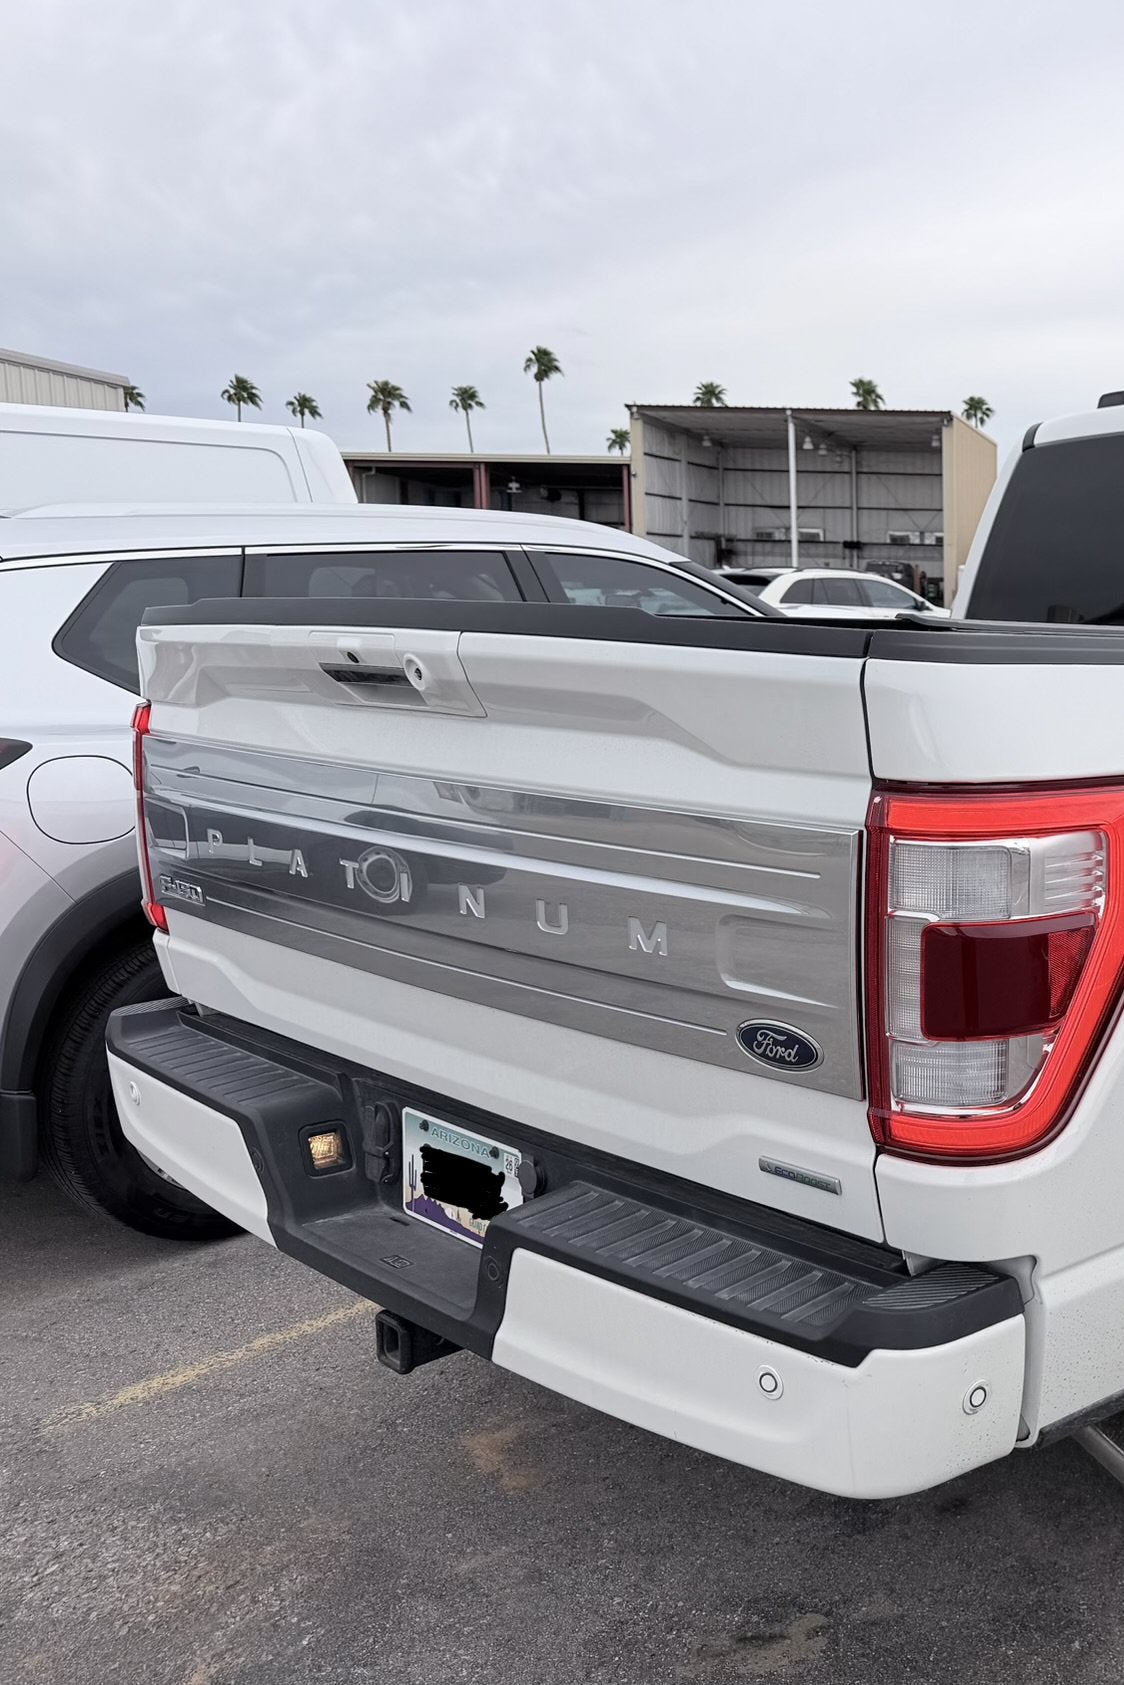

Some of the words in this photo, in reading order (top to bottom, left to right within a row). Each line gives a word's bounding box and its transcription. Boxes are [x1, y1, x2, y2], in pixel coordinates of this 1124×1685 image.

[207, 827, 668, 957] PLATINUM
[753, 1029, 799, 1063] Ford
[431, 1127, 490, 1158] ARIZONA
[774, 1166, 832, 1189] ECOBOOST
